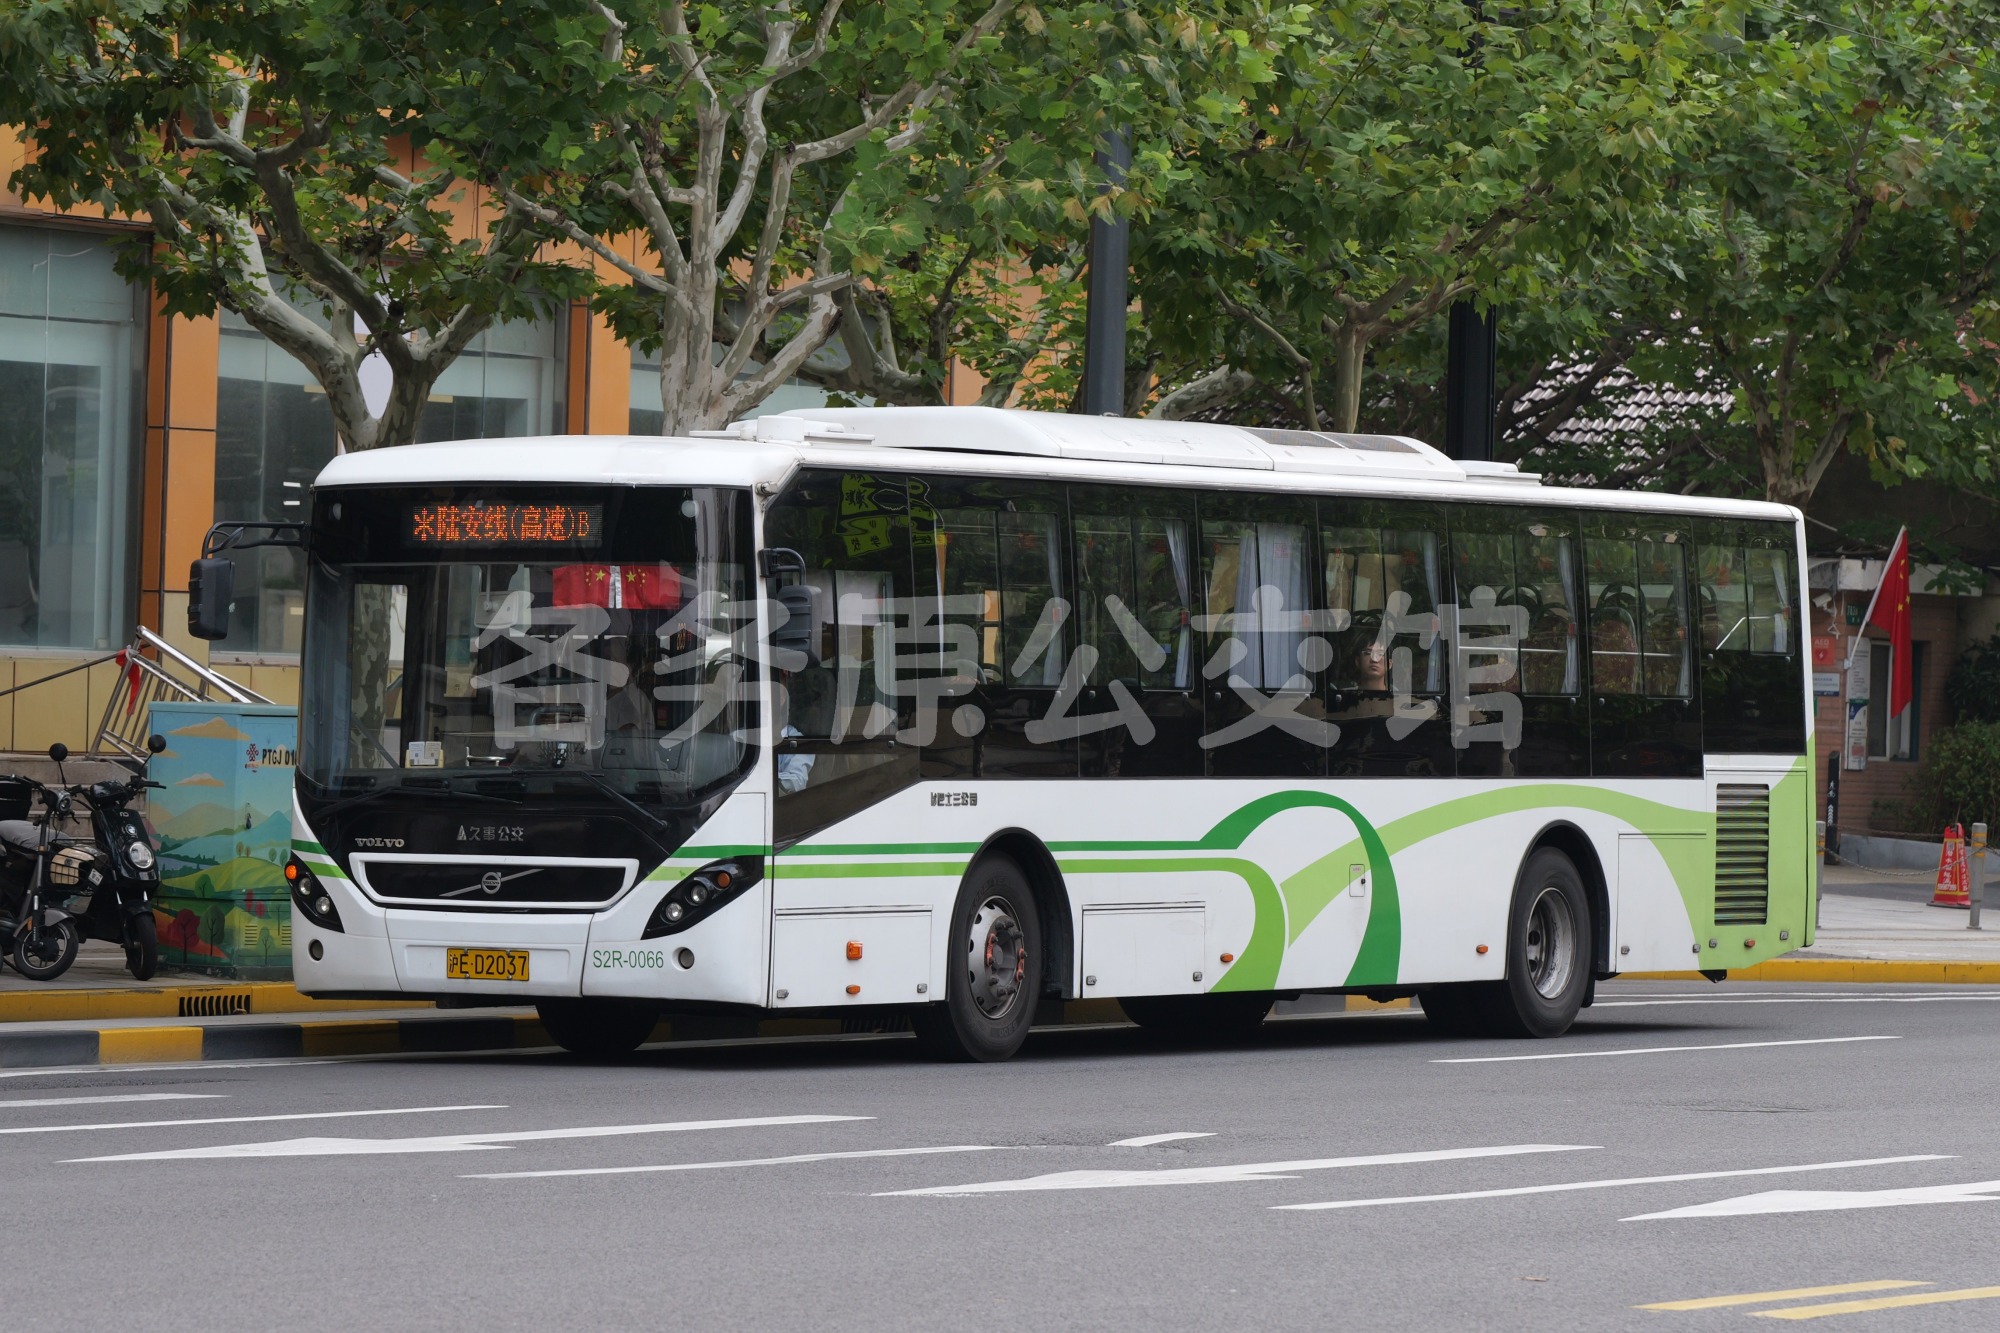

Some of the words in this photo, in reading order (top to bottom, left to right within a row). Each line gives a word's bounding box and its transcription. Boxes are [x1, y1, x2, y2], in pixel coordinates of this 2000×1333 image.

[262, 748, 282, 765] PTGJ
[468, 826, 525, 842] 久事公交
[355, 837, 405, 848] VOLVO
[592, 950, 665, 969] S2R-0066
